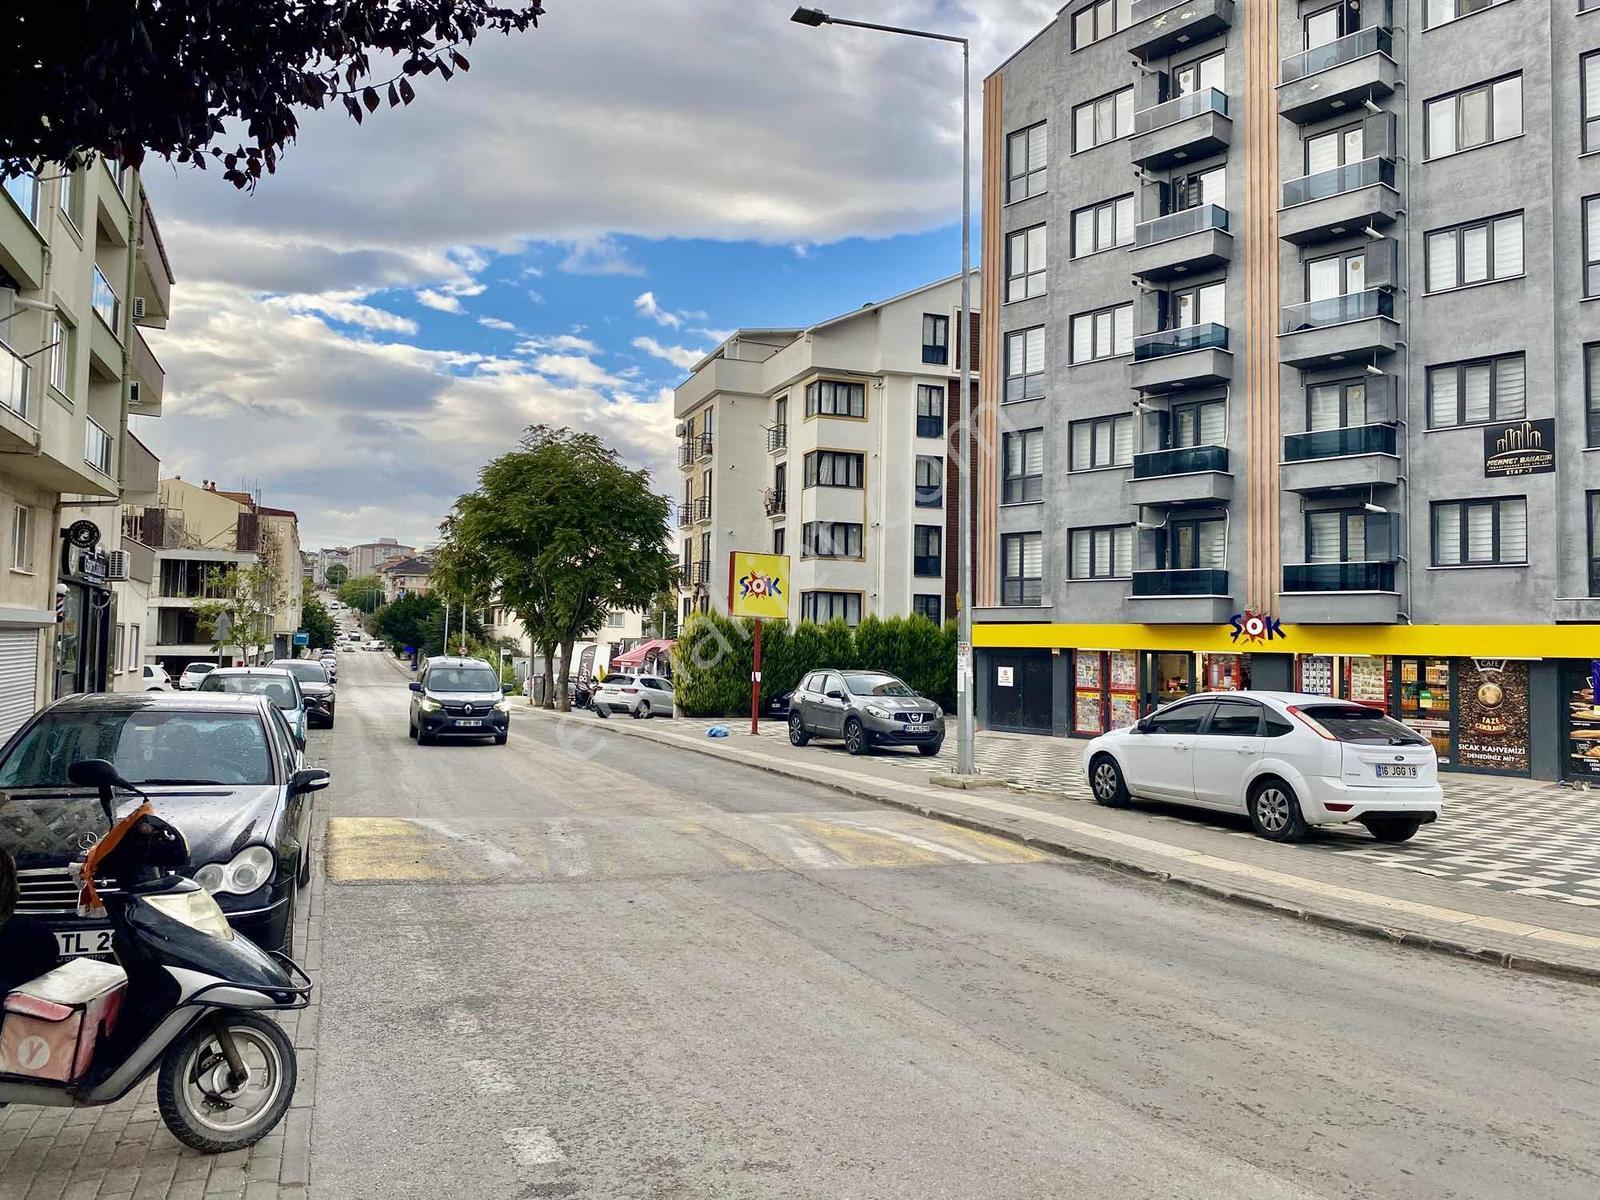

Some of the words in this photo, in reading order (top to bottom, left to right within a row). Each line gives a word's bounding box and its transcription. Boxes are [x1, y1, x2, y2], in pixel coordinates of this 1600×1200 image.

[739, 575, 782, 600] ŞOK
[1230, 612, 1287, 643] ŞOK
[1482, 716, 1499, 724] TAZE
[1467, 752, 1501, 761] DENEDİNİZ
[1482, 745, 1525, 754] KAHVEMİZİ
[61, 933, 89, 953] TL
